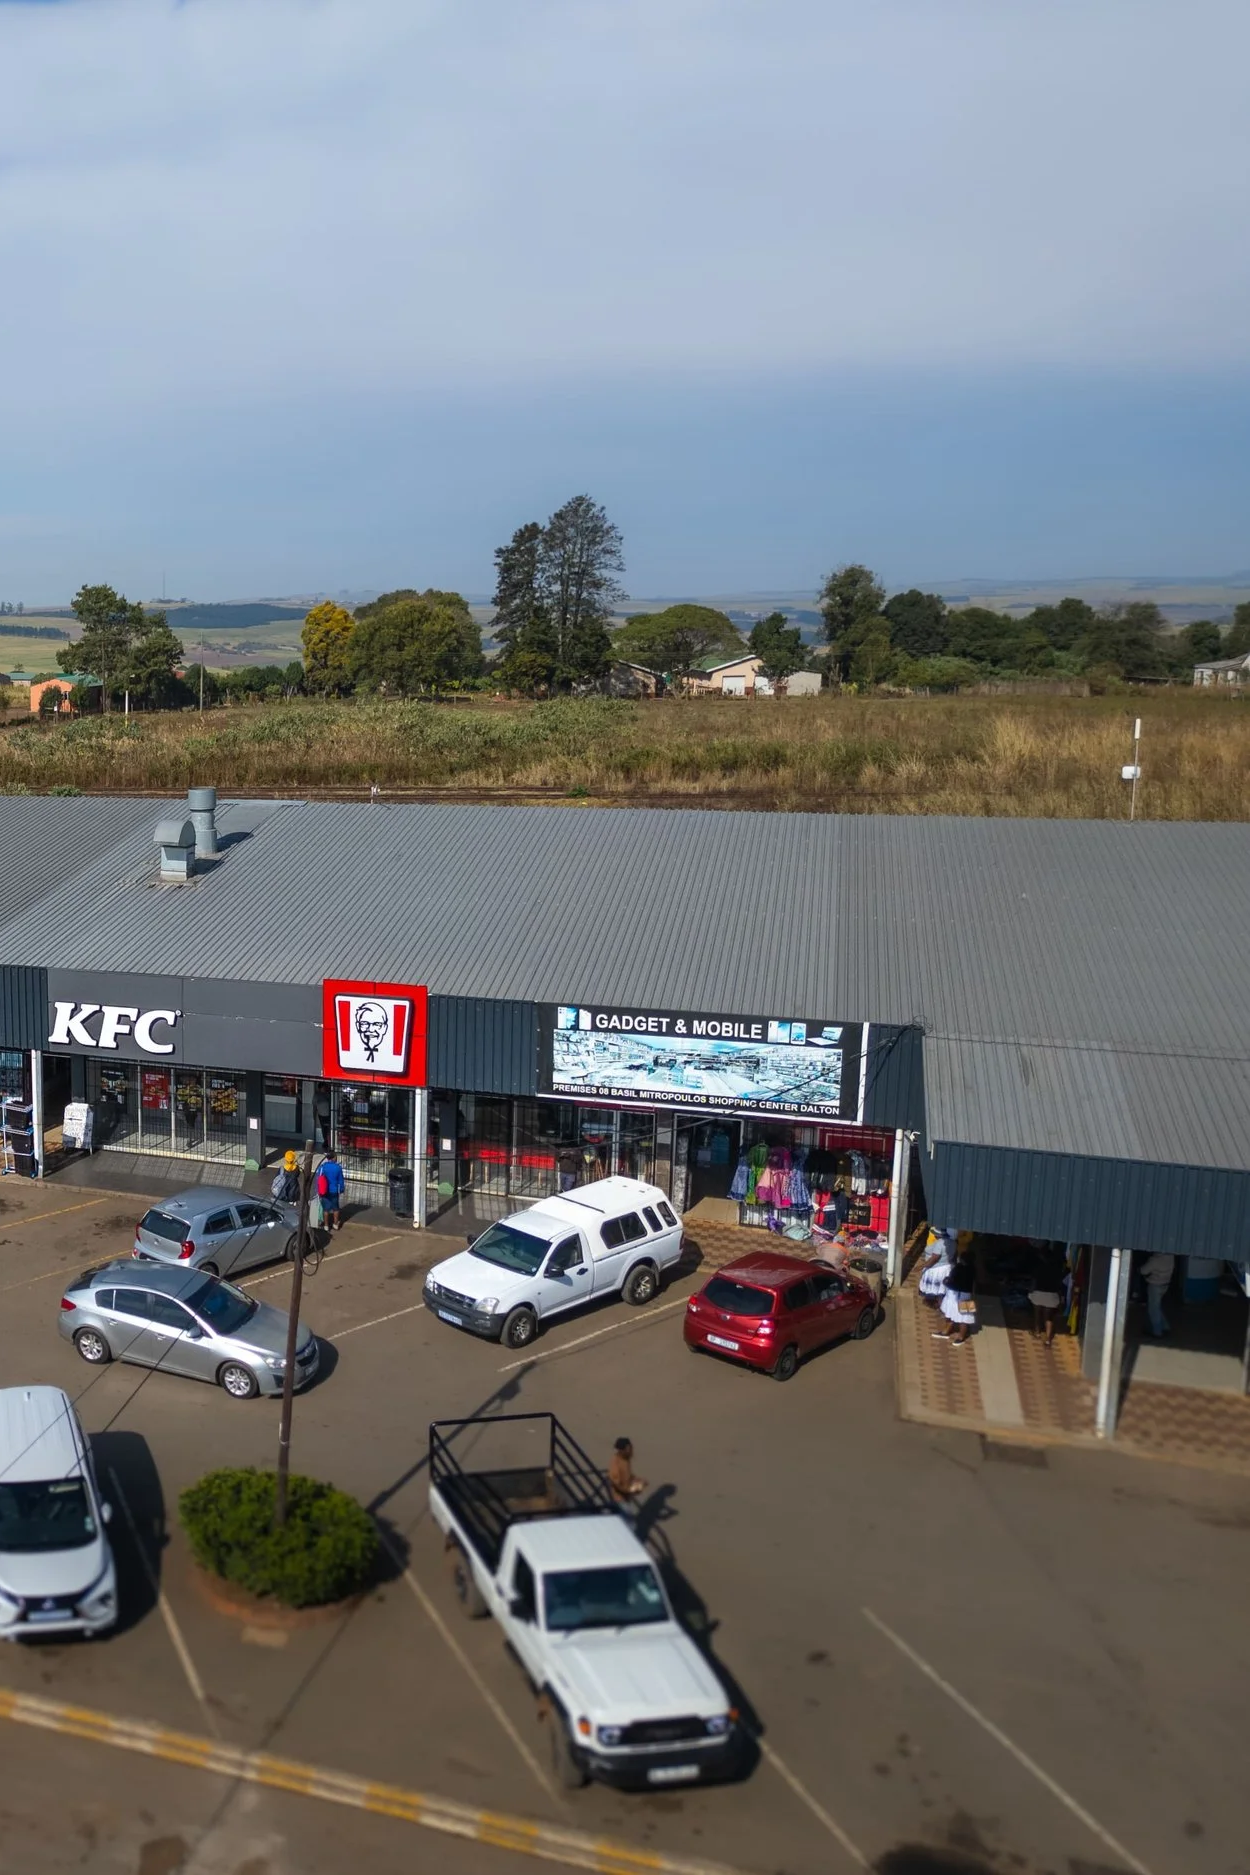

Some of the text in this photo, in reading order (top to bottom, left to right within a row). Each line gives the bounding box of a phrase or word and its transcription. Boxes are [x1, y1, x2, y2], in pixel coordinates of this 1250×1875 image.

[48, 1001, 176, 1054] KFC
[595, 1014, 763, 1039] GADGET & MOBILE
[553, 1084, 840, 1115] PREMISES 08 BASIL MITROPOULOS SHOPPING CENTER DALTON
